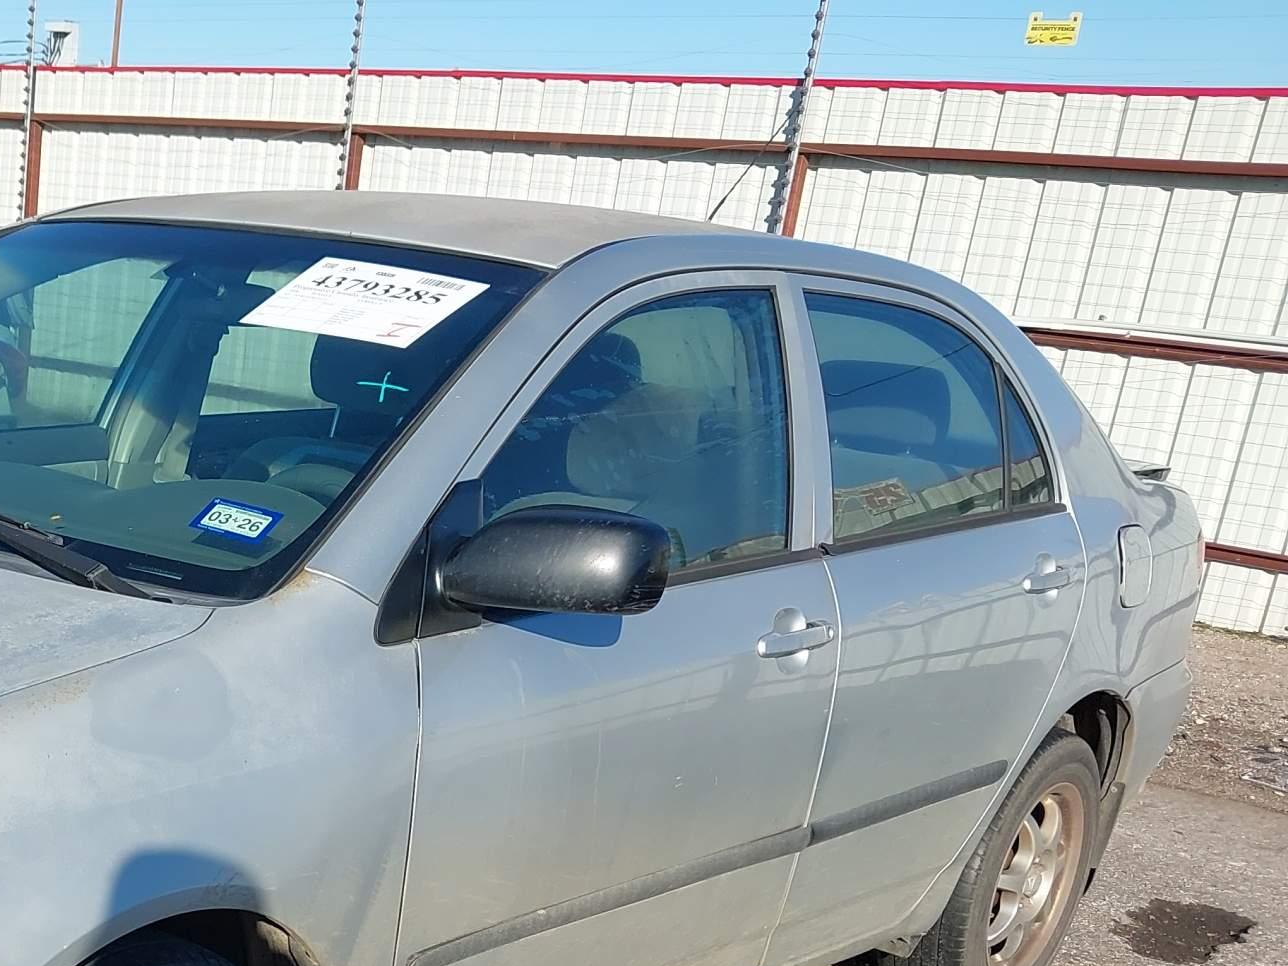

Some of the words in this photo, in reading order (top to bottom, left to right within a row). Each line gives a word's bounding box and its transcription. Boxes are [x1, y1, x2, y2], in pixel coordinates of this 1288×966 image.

[311, 274, 448, 305] 43793285
[208, 510, 233, 525] 03
[236, 517, 264, 532] 26
